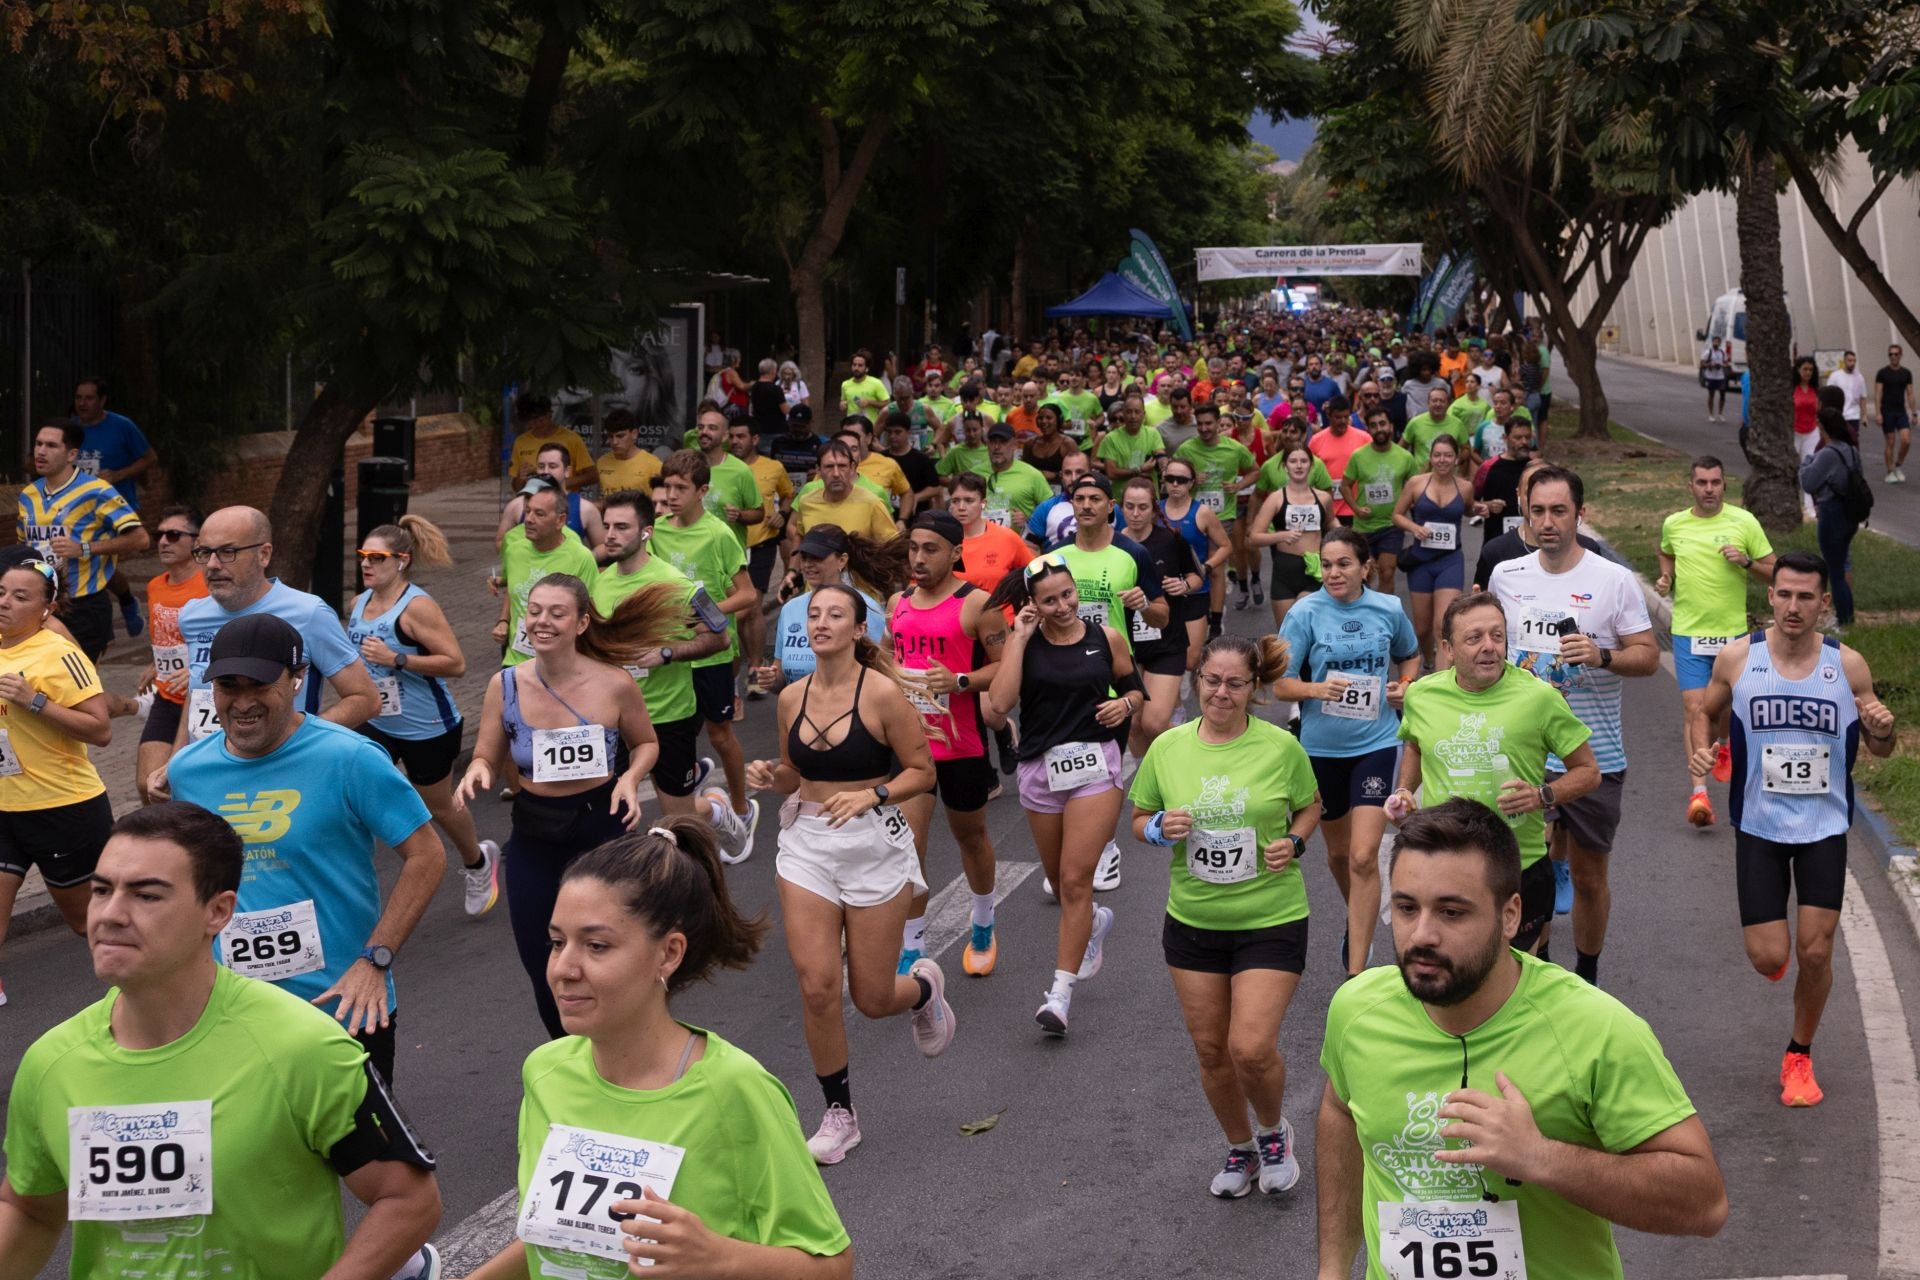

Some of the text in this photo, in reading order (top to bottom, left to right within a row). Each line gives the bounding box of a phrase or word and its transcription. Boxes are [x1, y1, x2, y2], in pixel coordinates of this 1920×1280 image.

[1255, 247, 1366, 258] Carrera de la Prensa
[639, 425, 670, 435] OSSY
[1368, 489, 1389, 499] 633
[1290, 513, 1316, 524] 572
[156, 658, 184, 672] 270
[1325, 653, 1385, 674] nerja
[1339, 689, 1372, 706] 81
[1752, 699, 1836, 732] ADESA
[543, 744, 594, 765] 109
[1050, 753, 1098, 774] 1059
[1780, 762, 1811, 778] 13
[1194, 847, 1244, 868] 497
[231, 930, 302, 963] 269
[105, 1115, 162, 1131] Carrera
[116, 1127, 169, 1141] Prensa
[579, 1138, 636, 1164] Carrera
[89, 1143, 185, 1185] 590
[587, 1157, 635, 1176] Prensa
[1395, 1168, 1477, 1188] Prensa
[1419, 1211, 1475, 1227] Carrera
[598, 1224, 616, 1235] TERESA
[1430, 1224, 1481, 1237] Prensa
[1399, 1240, 1498, 1279] 165
